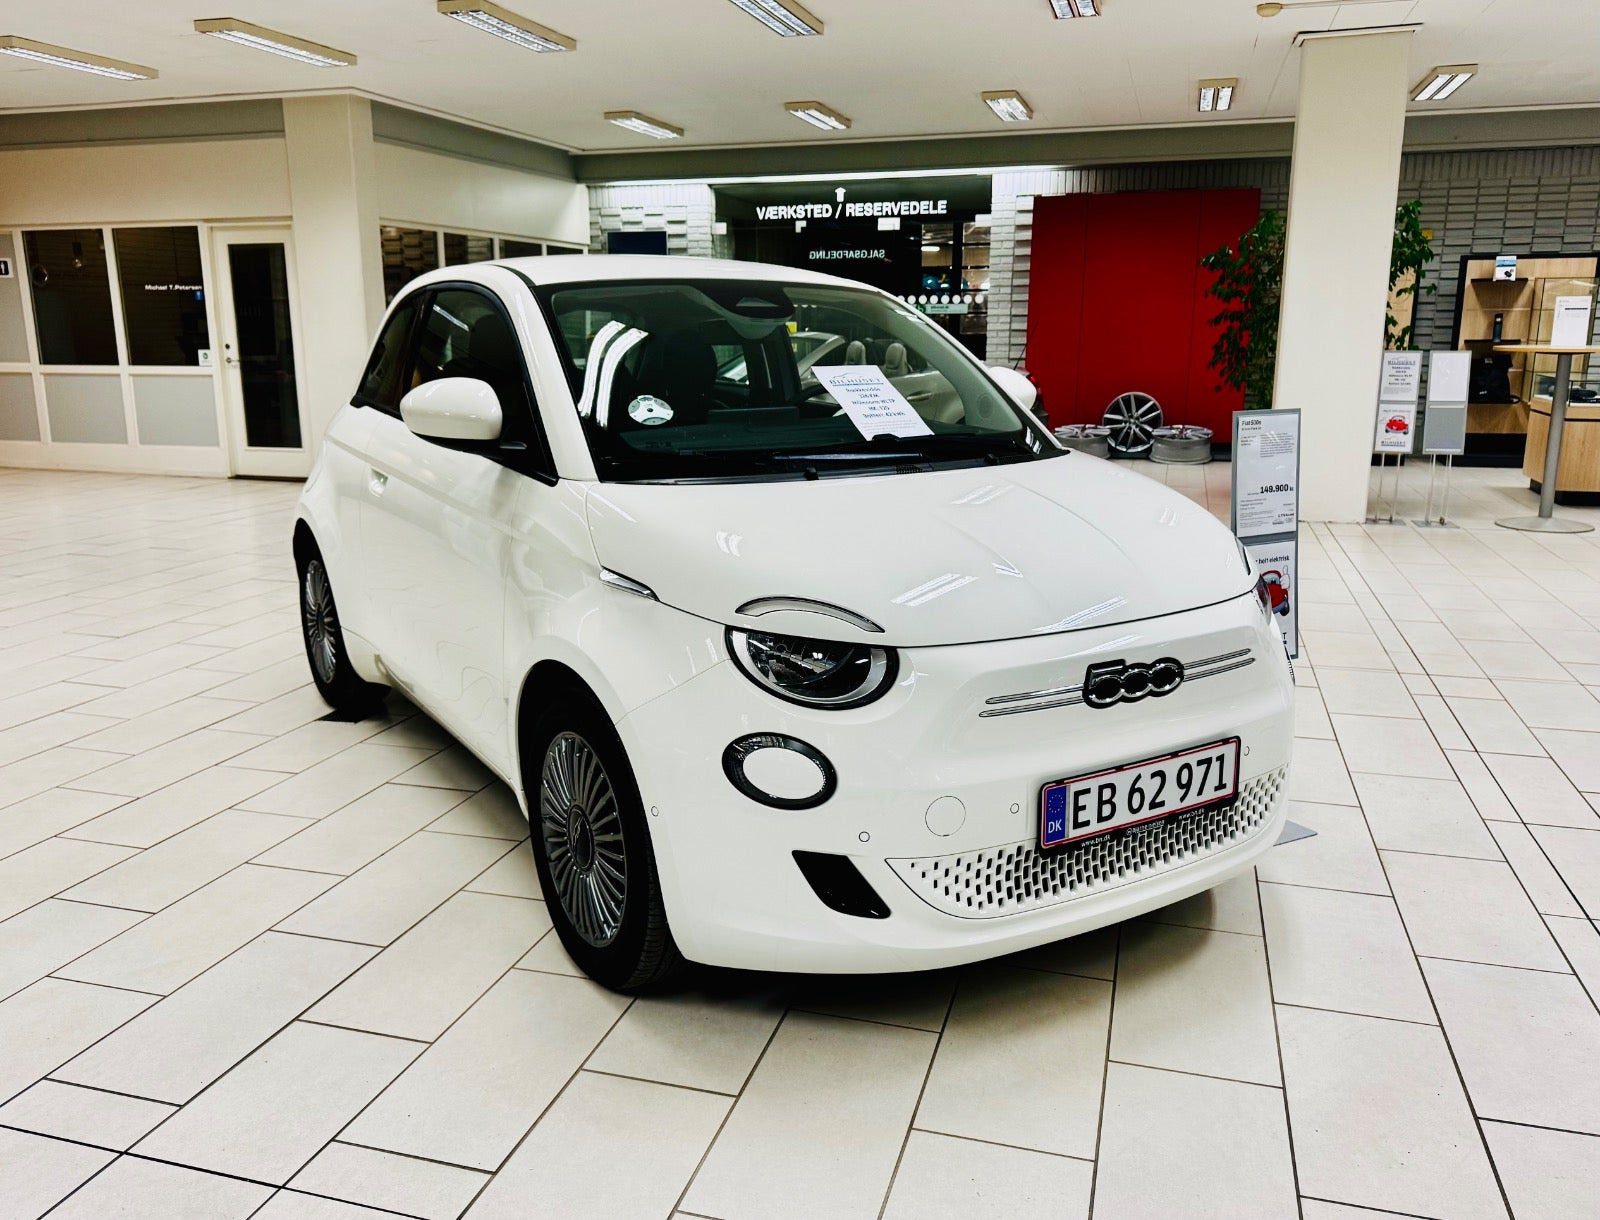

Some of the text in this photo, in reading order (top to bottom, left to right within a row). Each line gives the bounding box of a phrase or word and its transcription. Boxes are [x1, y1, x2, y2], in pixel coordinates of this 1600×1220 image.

[756, 203, 832, 220] VÆRKSTED
[846, 200, 947, 217] RESERVEDELE
[1260, 484, 1289, 494] 149.900
[1085, 659, 1183, 706] 500
[1048, 753, 1227, 834] DK EB 62 971
